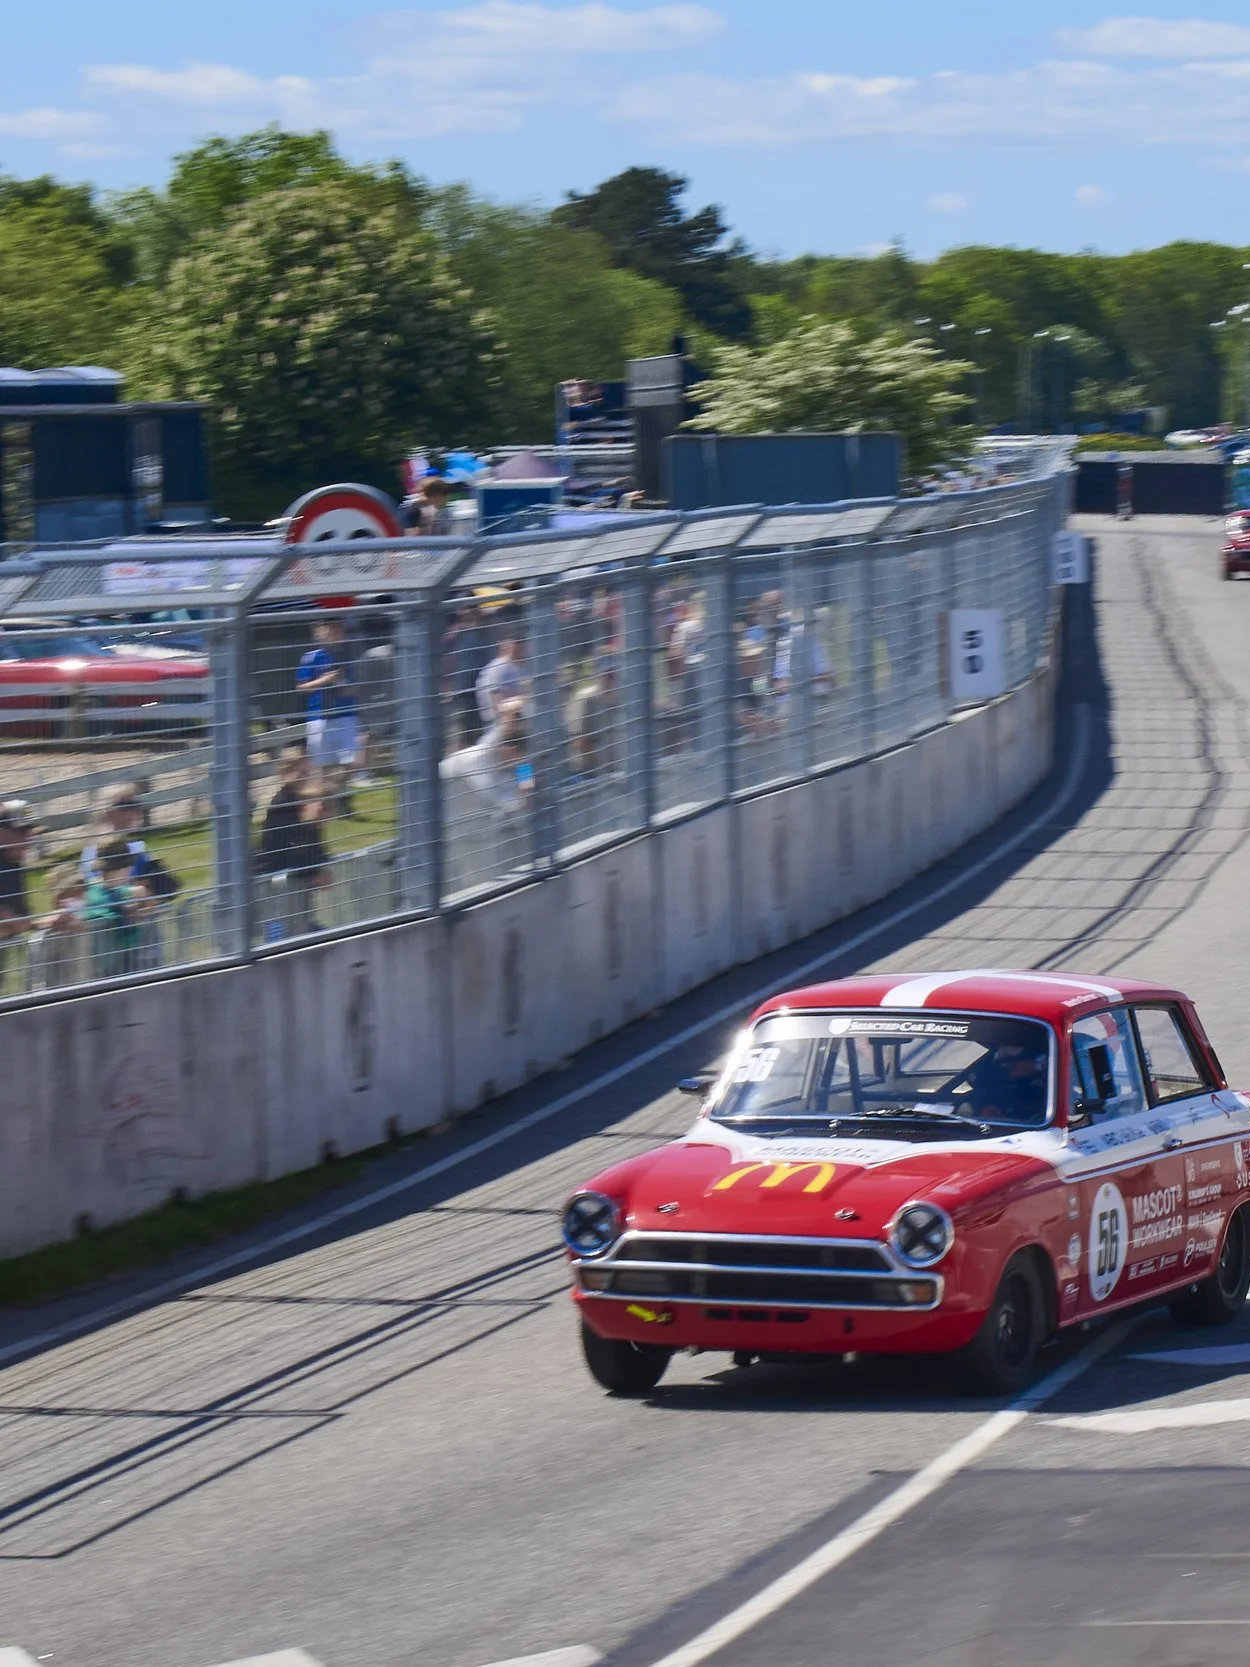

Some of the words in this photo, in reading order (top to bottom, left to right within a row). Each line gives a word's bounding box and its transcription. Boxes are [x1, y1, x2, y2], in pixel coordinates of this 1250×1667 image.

[962, 629, 984, 675] 50
[731, 1048, 781, 1083] 56
[1097, 1208, 1119, 1277] 56
[1133, 1215, 1183, 1249] WORKWEAR
